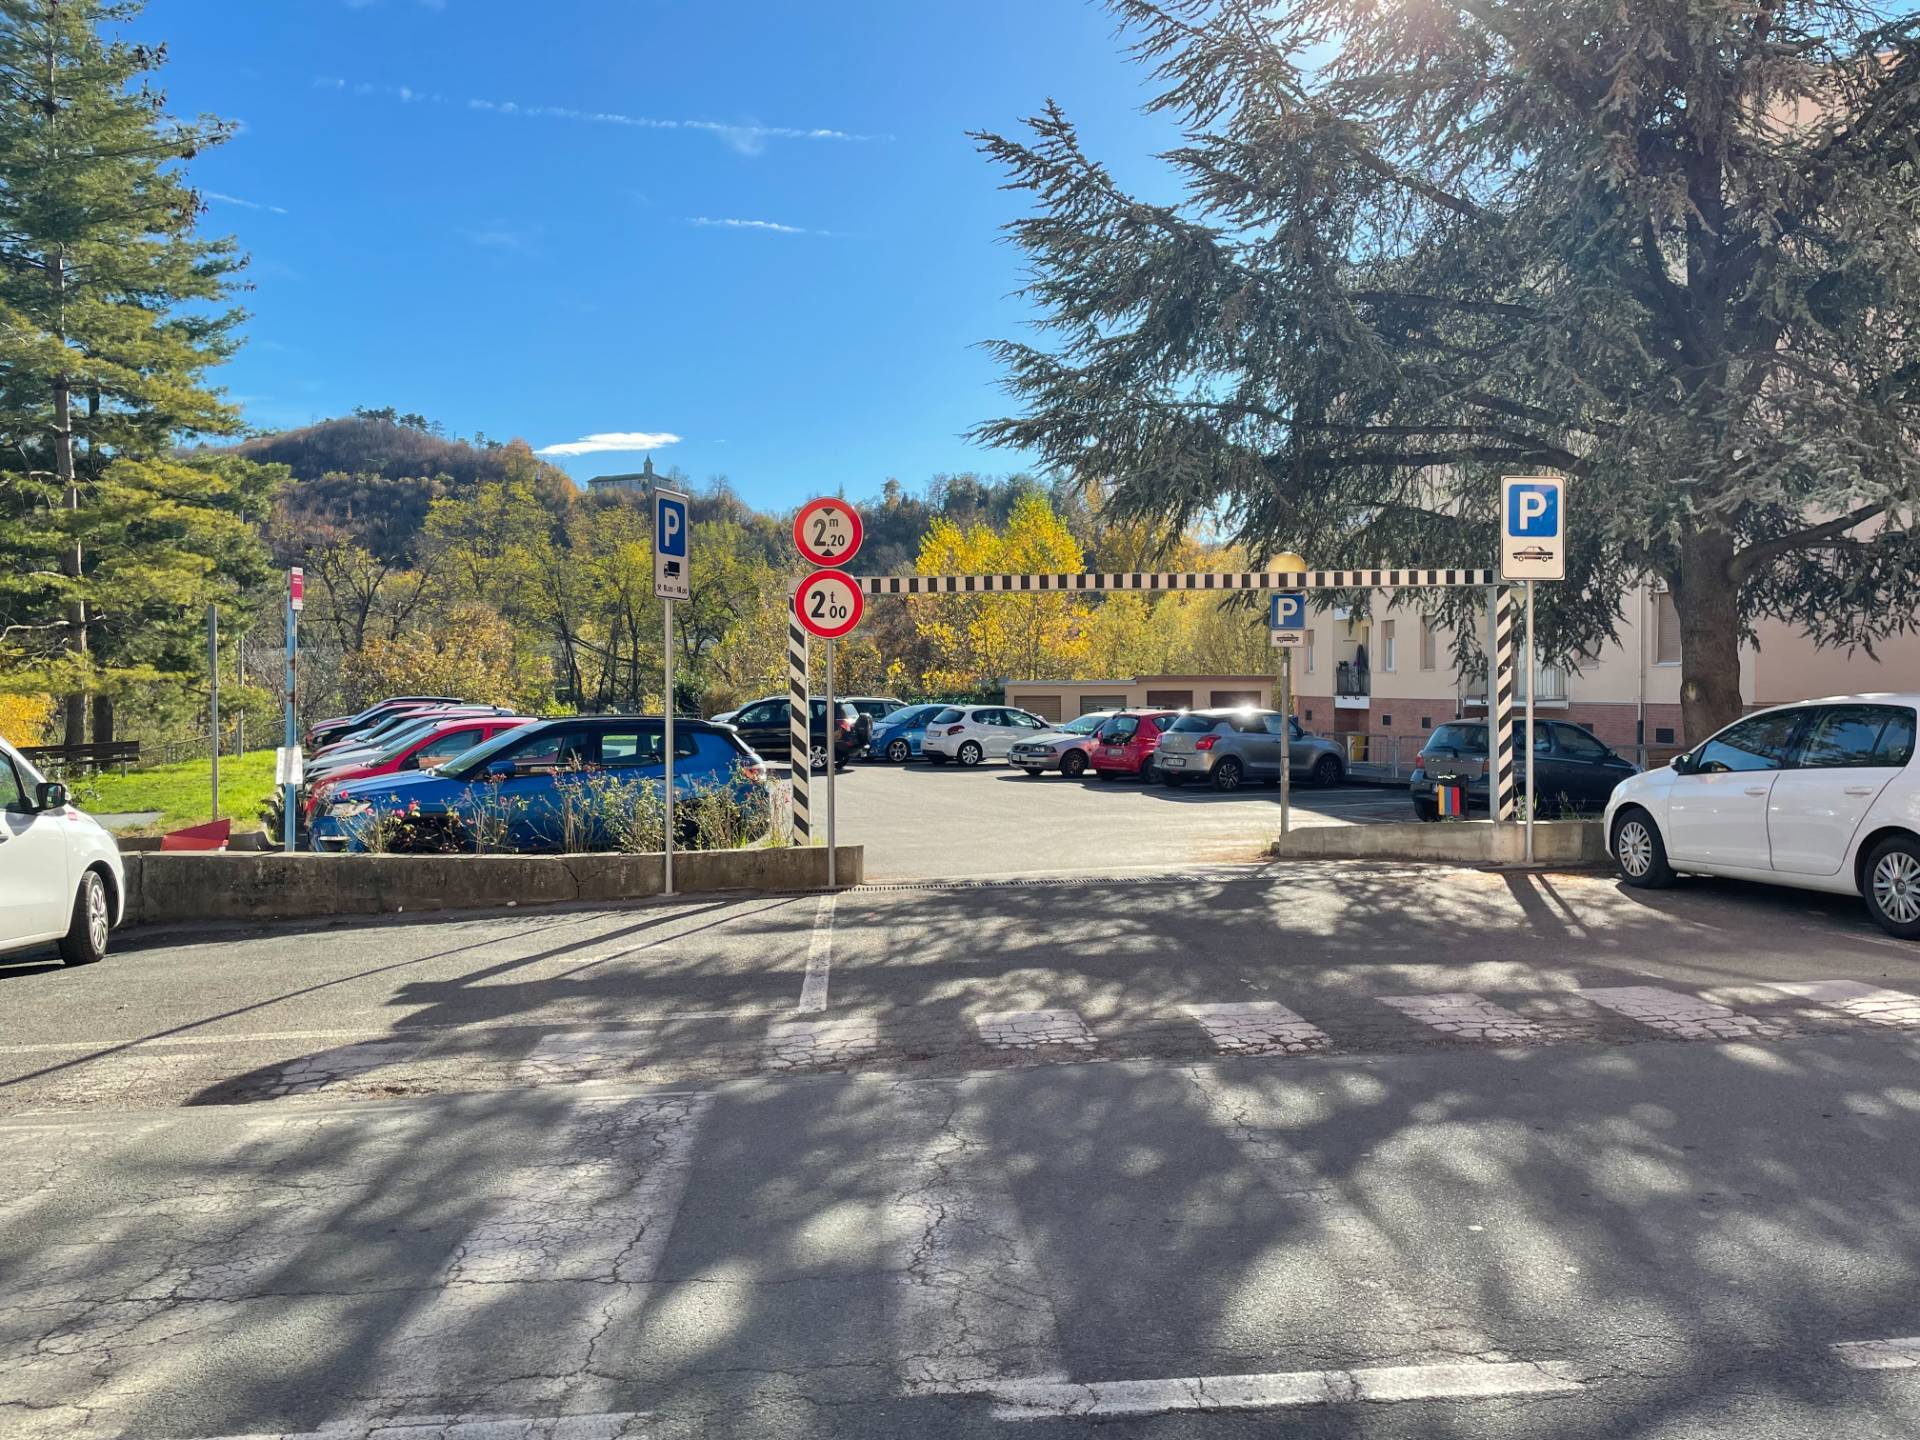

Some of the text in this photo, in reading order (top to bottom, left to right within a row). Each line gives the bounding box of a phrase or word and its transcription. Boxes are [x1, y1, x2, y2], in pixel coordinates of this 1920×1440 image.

[829, 518, 839, 527] m
[1519, 491, 1547, 530] P
[664, 507, 680, 547] P
[830, 591, 836, 603] t
[1277, 597, 1298, 625] P
